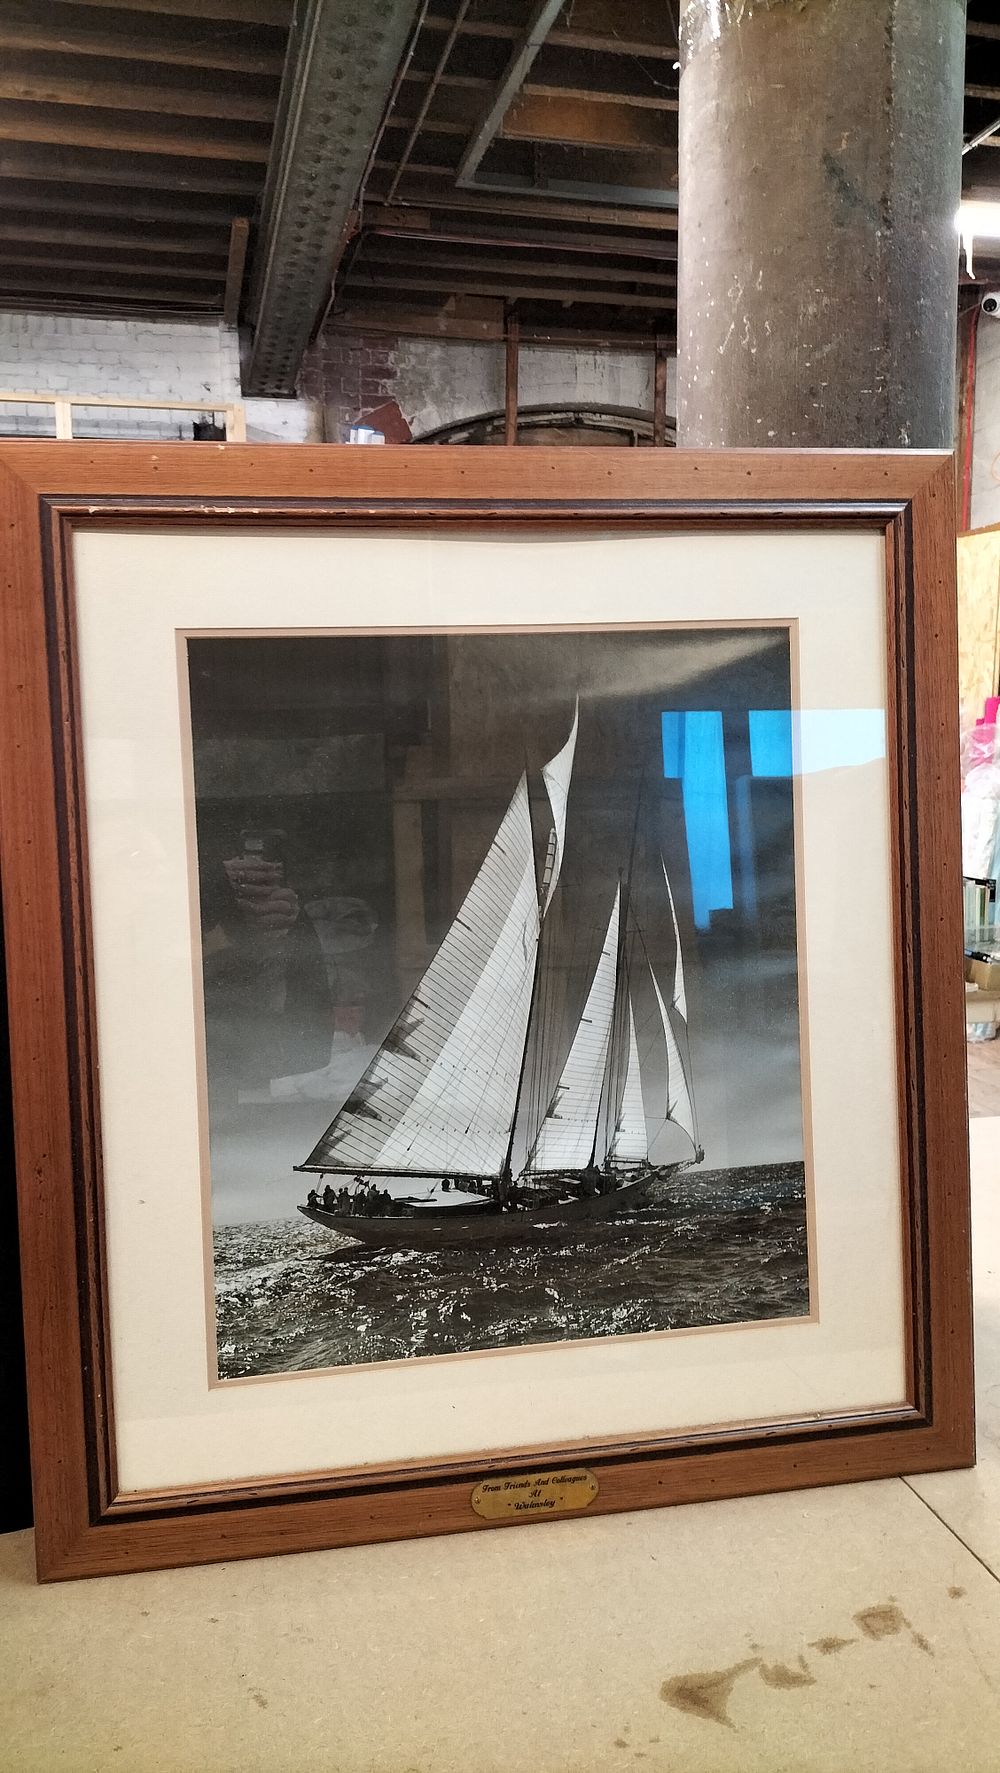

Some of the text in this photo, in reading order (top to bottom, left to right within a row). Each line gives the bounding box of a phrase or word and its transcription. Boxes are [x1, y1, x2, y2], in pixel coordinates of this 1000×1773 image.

[481, 1474, 588, 1493] From Friends And Colleagues
[528, 1489, 542, 1498] At
